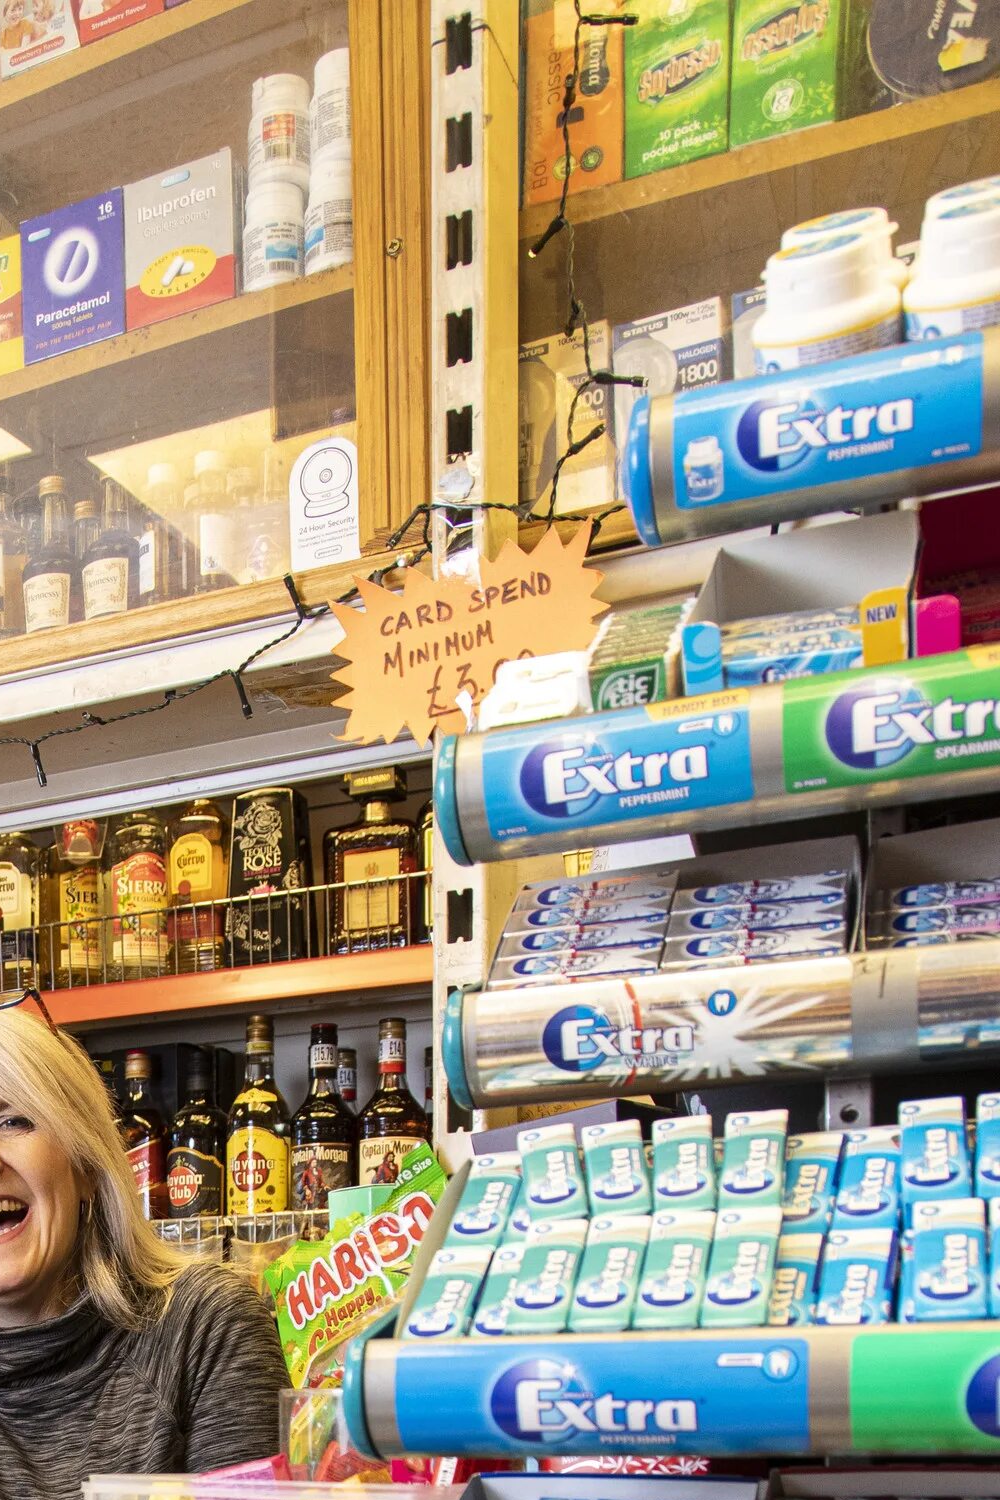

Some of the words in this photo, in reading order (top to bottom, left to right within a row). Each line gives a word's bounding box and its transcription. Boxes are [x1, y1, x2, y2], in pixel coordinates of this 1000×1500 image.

[659, 130, 671, 141] 10
[674, 122, 700, 139] pack
[642, 141, 679, 162] pocket
[682, 130, 717, 152] tissues
[98, 201, 113, 215] 16
[136, 185, 216, 224] Ibuprofen
[35, 292, 110, 328] Paracetamol
[623, 320, 663, 337] STATUS
[678, 344, 716, 360] HALOGEN
[678, 360, 717, 385] 1800
[759, 398, 914, 459] Extra
[299, 527, 308, 535] 24
[309, 522, 326, 532] Hour
[327, 515, 355, 528] Security
[28, 591, 61, 601] Hennessy
[378, 602, 453, 638] CARD
[467, 572, 552, 613] SPEND
[866, 605, 897, 623] NEW
[383, 621, 494, 675] MINIMUM
[615, 674, 649, 693] tic
[662, 701, 709, 717] HANDY
[713, 693, 740, 709] BOX
[543, 741, 711, 802] Extra
[619, 787, 690, 808] PEPPERMINT
[243, 848, 281, 857] TEQUILA
[243, 854, 282, 870] ROSE
[625, 1054, 679, 1068] WHITE
[316, 1147, 349, 1162] Morgan
[414, 1157, 432, 1174] Size
[169, 1186, 191, 1200] Club
[287, 1195, 434, 1328] HARIBO
[325, 1287, 376, 1323] Happy
